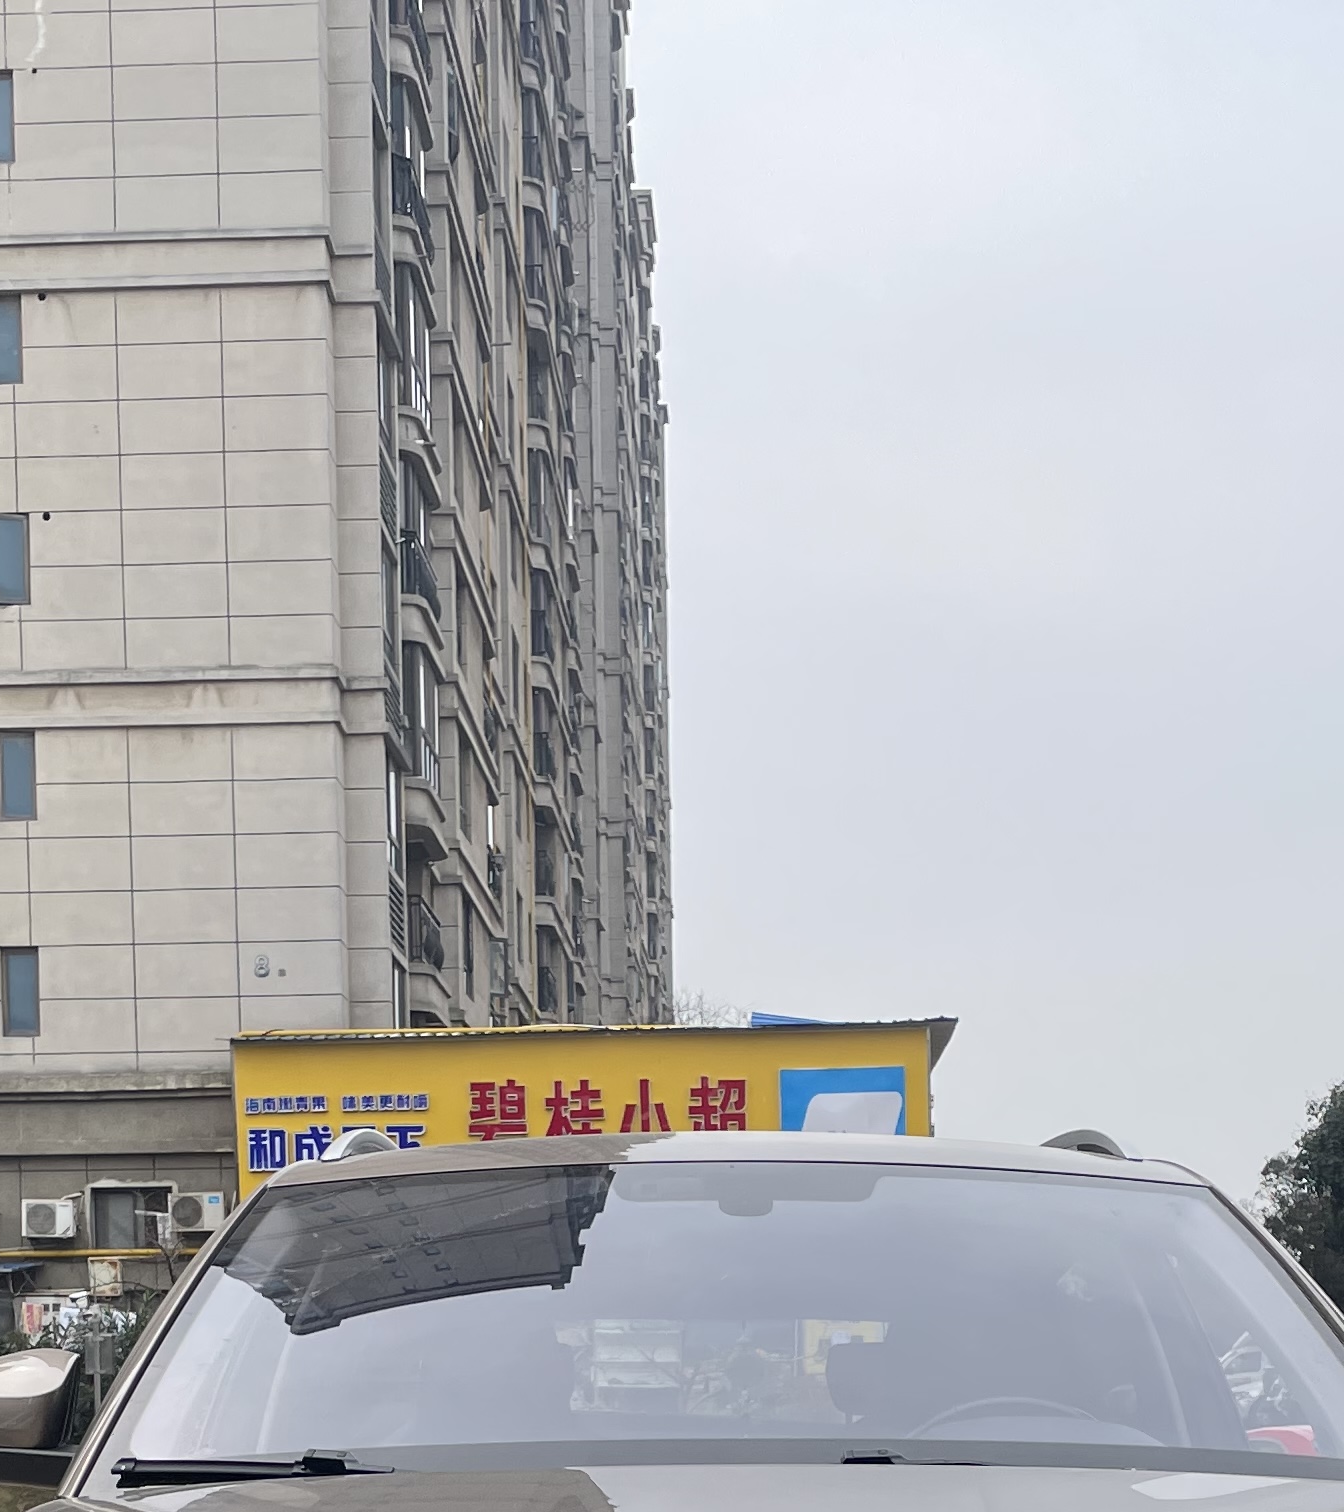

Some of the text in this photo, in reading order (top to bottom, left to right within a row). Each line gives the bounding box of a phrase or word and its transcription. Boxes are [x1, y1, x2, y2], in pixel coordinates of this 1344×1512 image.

[468, 1076, 747, 1141] 碧桂小超
[248, 1125, 425, 1170] 和成下
